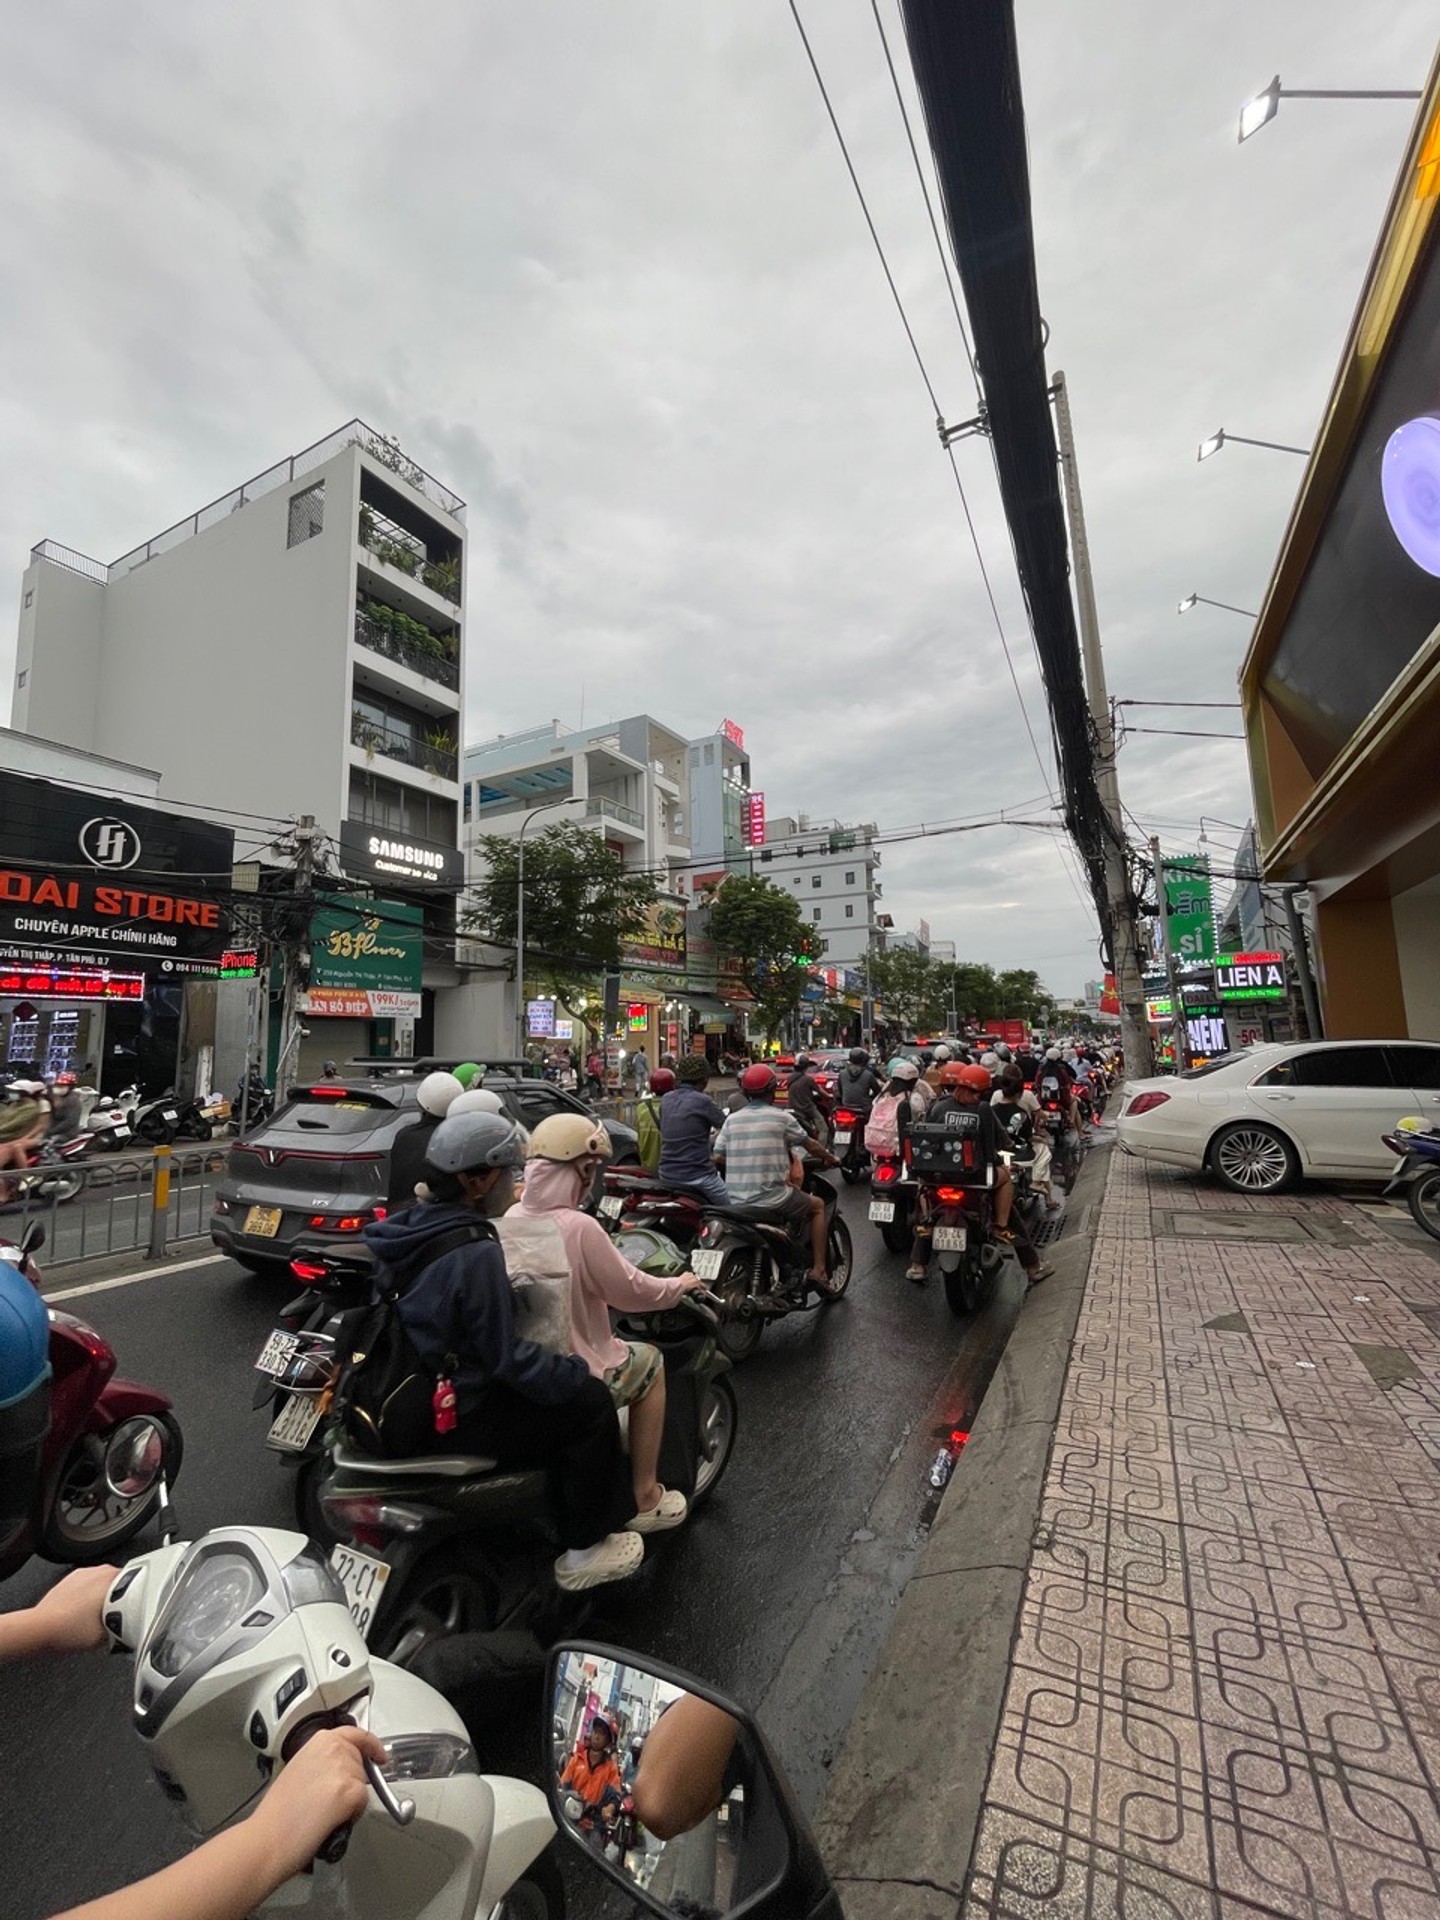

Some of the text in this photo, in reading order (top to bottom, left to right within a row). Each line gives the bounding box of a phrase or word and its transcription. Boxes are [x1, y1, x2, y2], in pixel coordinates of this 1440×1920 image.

[369, 836, 444, 870] SAMSUNG
[94, 886, 220, 929] STORE
[14, 917, 69, 935] CHUYÊN
[71, 924, 110, 939] APPLE
[111, 928, 147, 944] CHÍNH
[223, 954, 257, 968] iPhone
